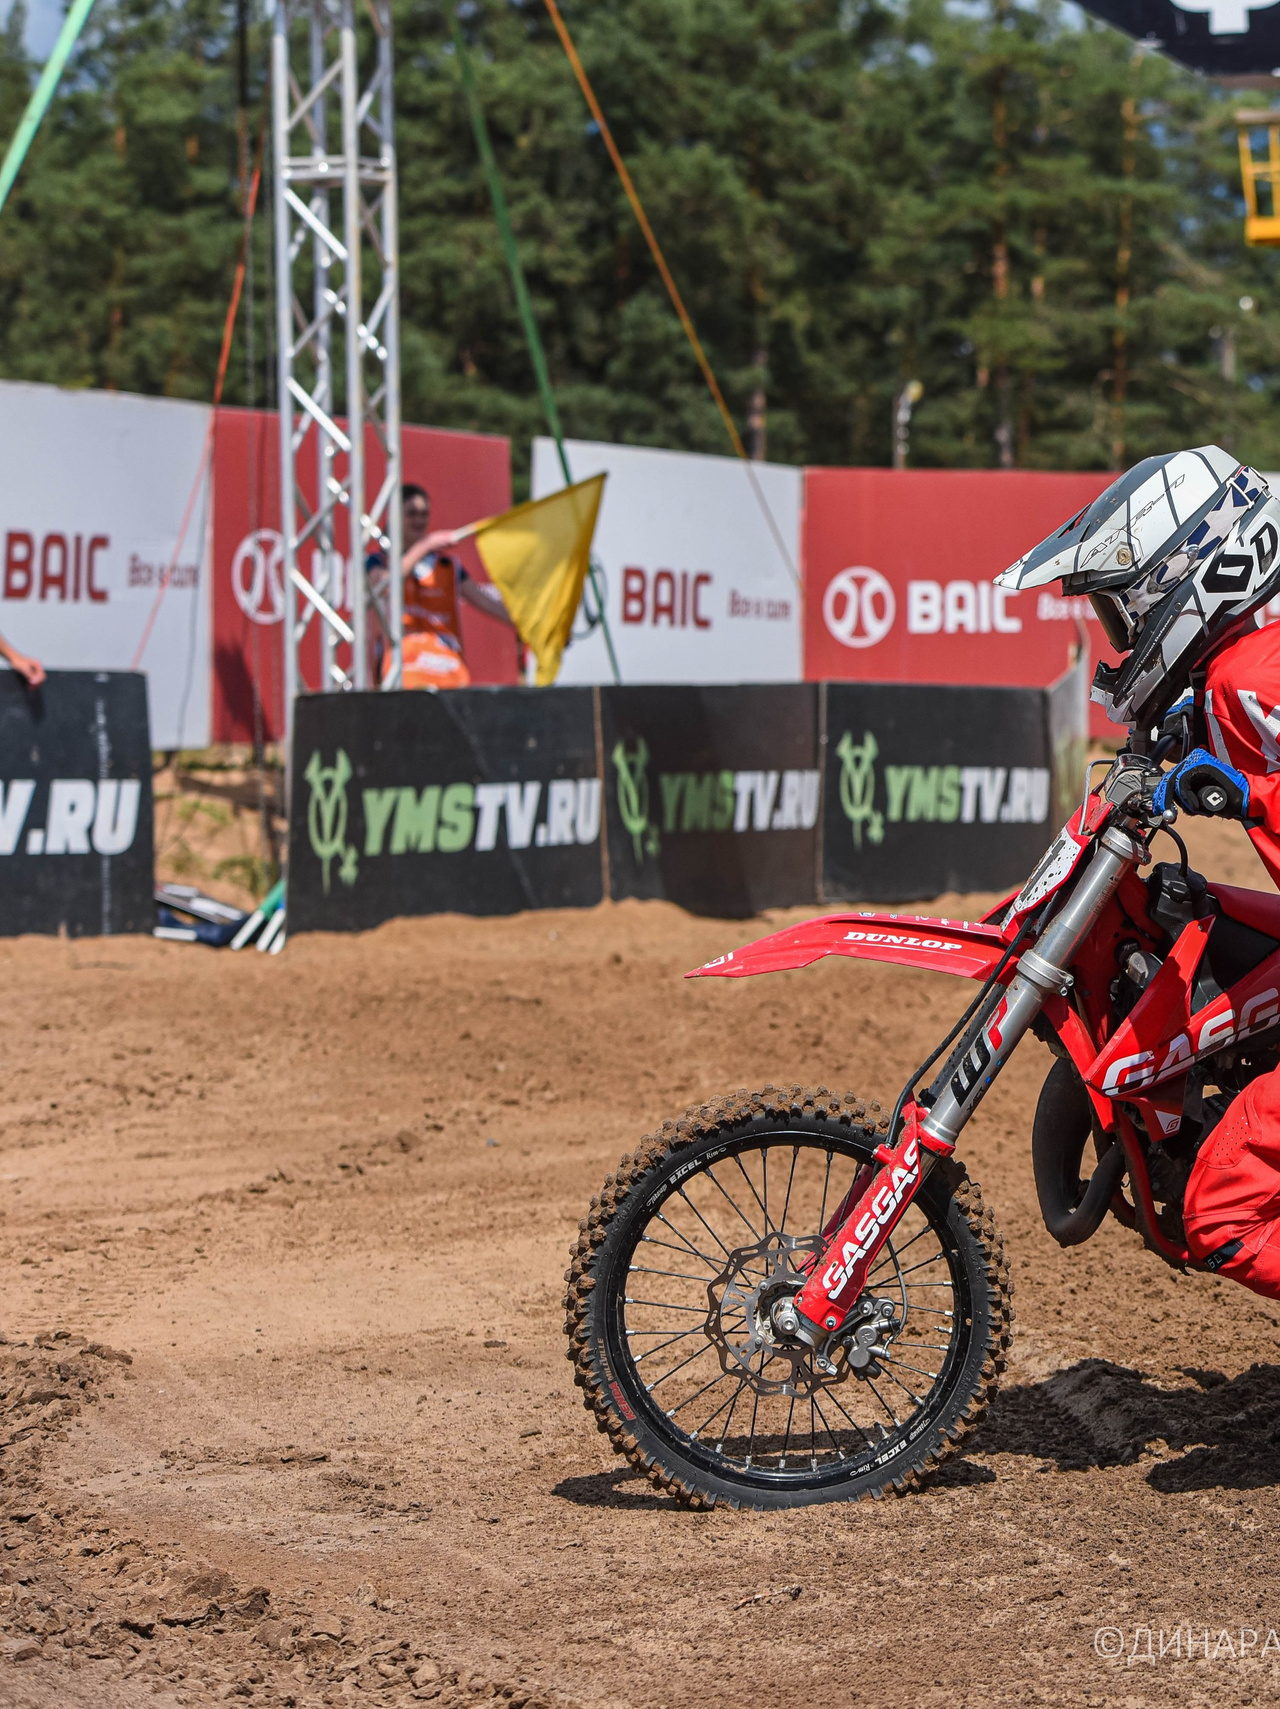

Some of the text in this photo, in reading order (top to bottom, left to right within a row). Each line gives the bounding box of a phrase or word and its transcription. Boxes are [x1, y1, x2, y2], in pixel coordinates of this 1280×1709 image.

[3, 530, 110, 603] BAIC
[622, 566, 712, 630] BAIC
[907, 580, 1021, 634] BAIC
[362, 778, 600, 857] YMSTV.RU
[659, 769, 820, 833] YMSTV.RU
[884, 766, 1049, 824] YMSTV.RU
[843, 931, 963, 951] DUNLOP
[669, 1159, 702, 1184] EXCEL
[610, 1381, 637, 1421] KENDA
[874, 1440, 907, 1465] EXCEL
